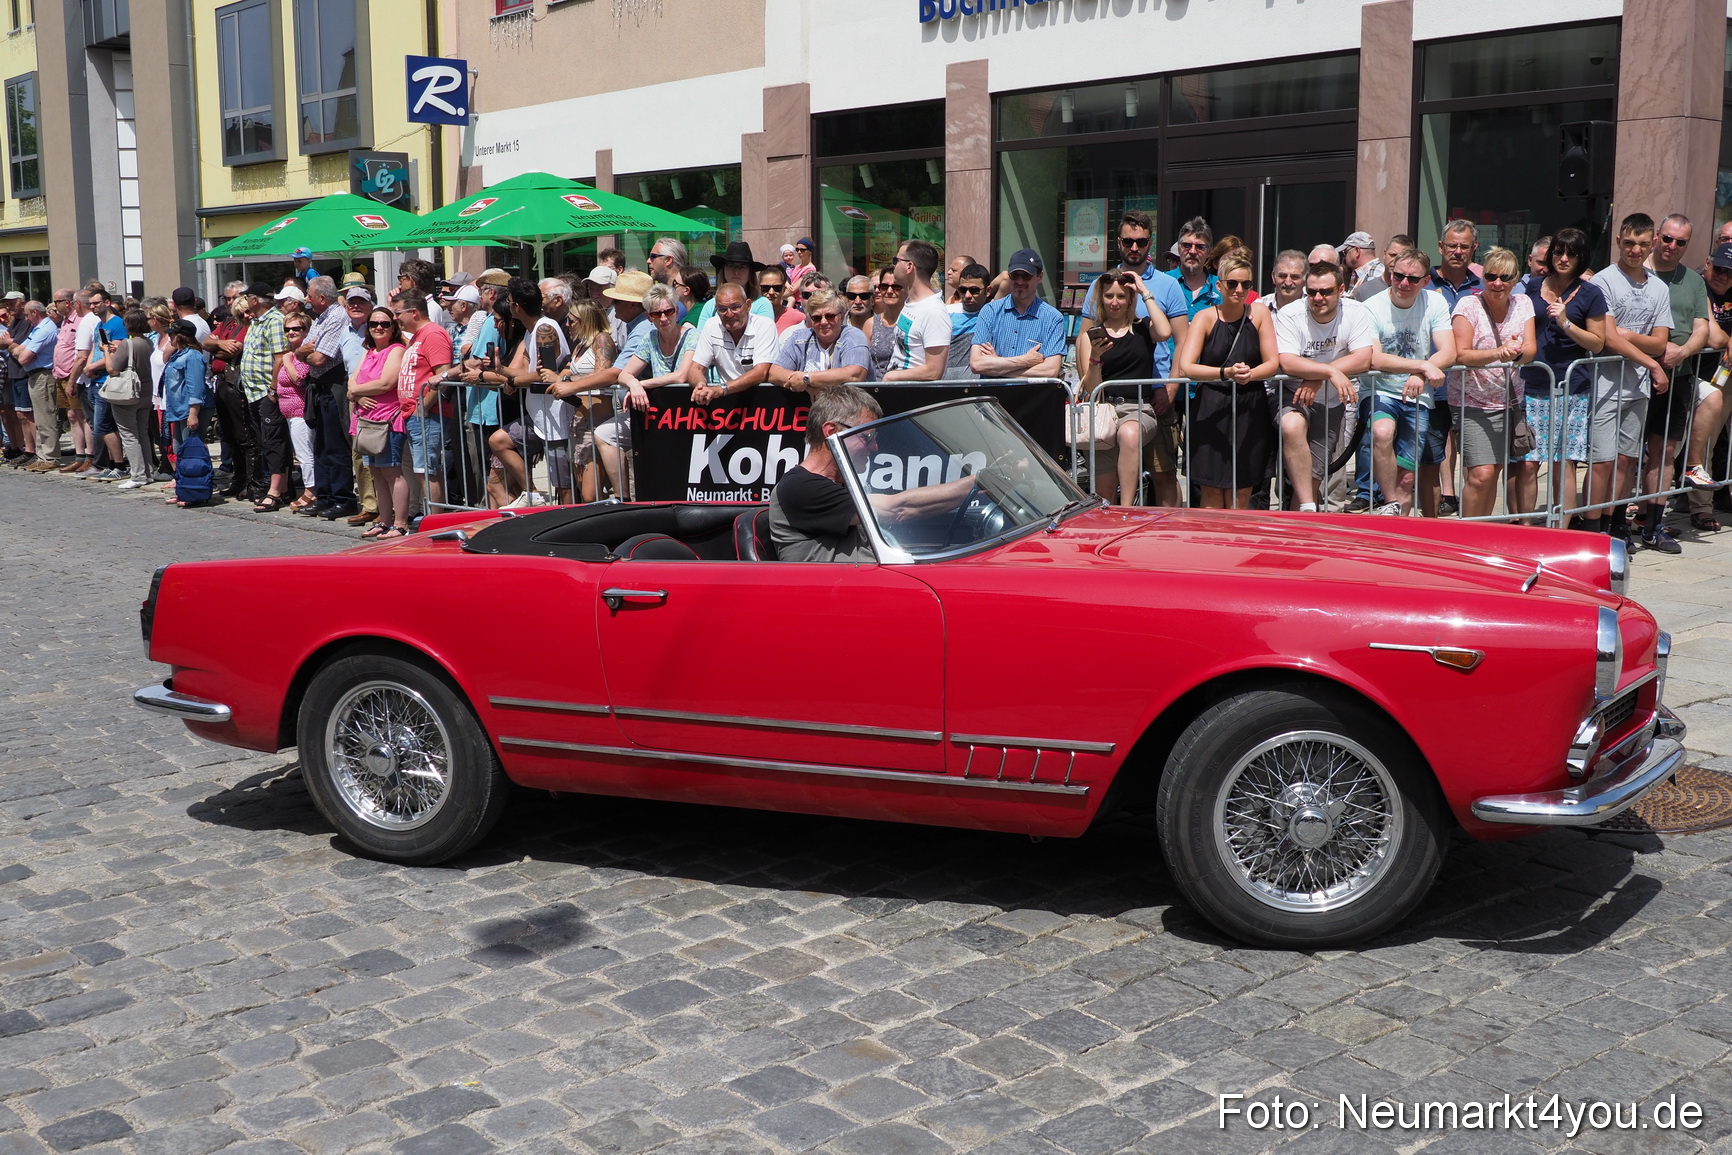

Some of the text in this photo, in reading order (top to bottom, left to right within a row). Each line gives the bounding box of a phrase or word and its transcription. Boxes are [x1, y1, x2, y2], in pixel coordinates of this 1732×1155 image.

[475, 139, 520, 157] Unterer Markt 15
[375, 168, 395, 194] G2
[913, 212, 942, 223] Grillen
[644, 406, 811, 432] FAHRSCHULE
[686, 487, 752, 502] Neumarkt
